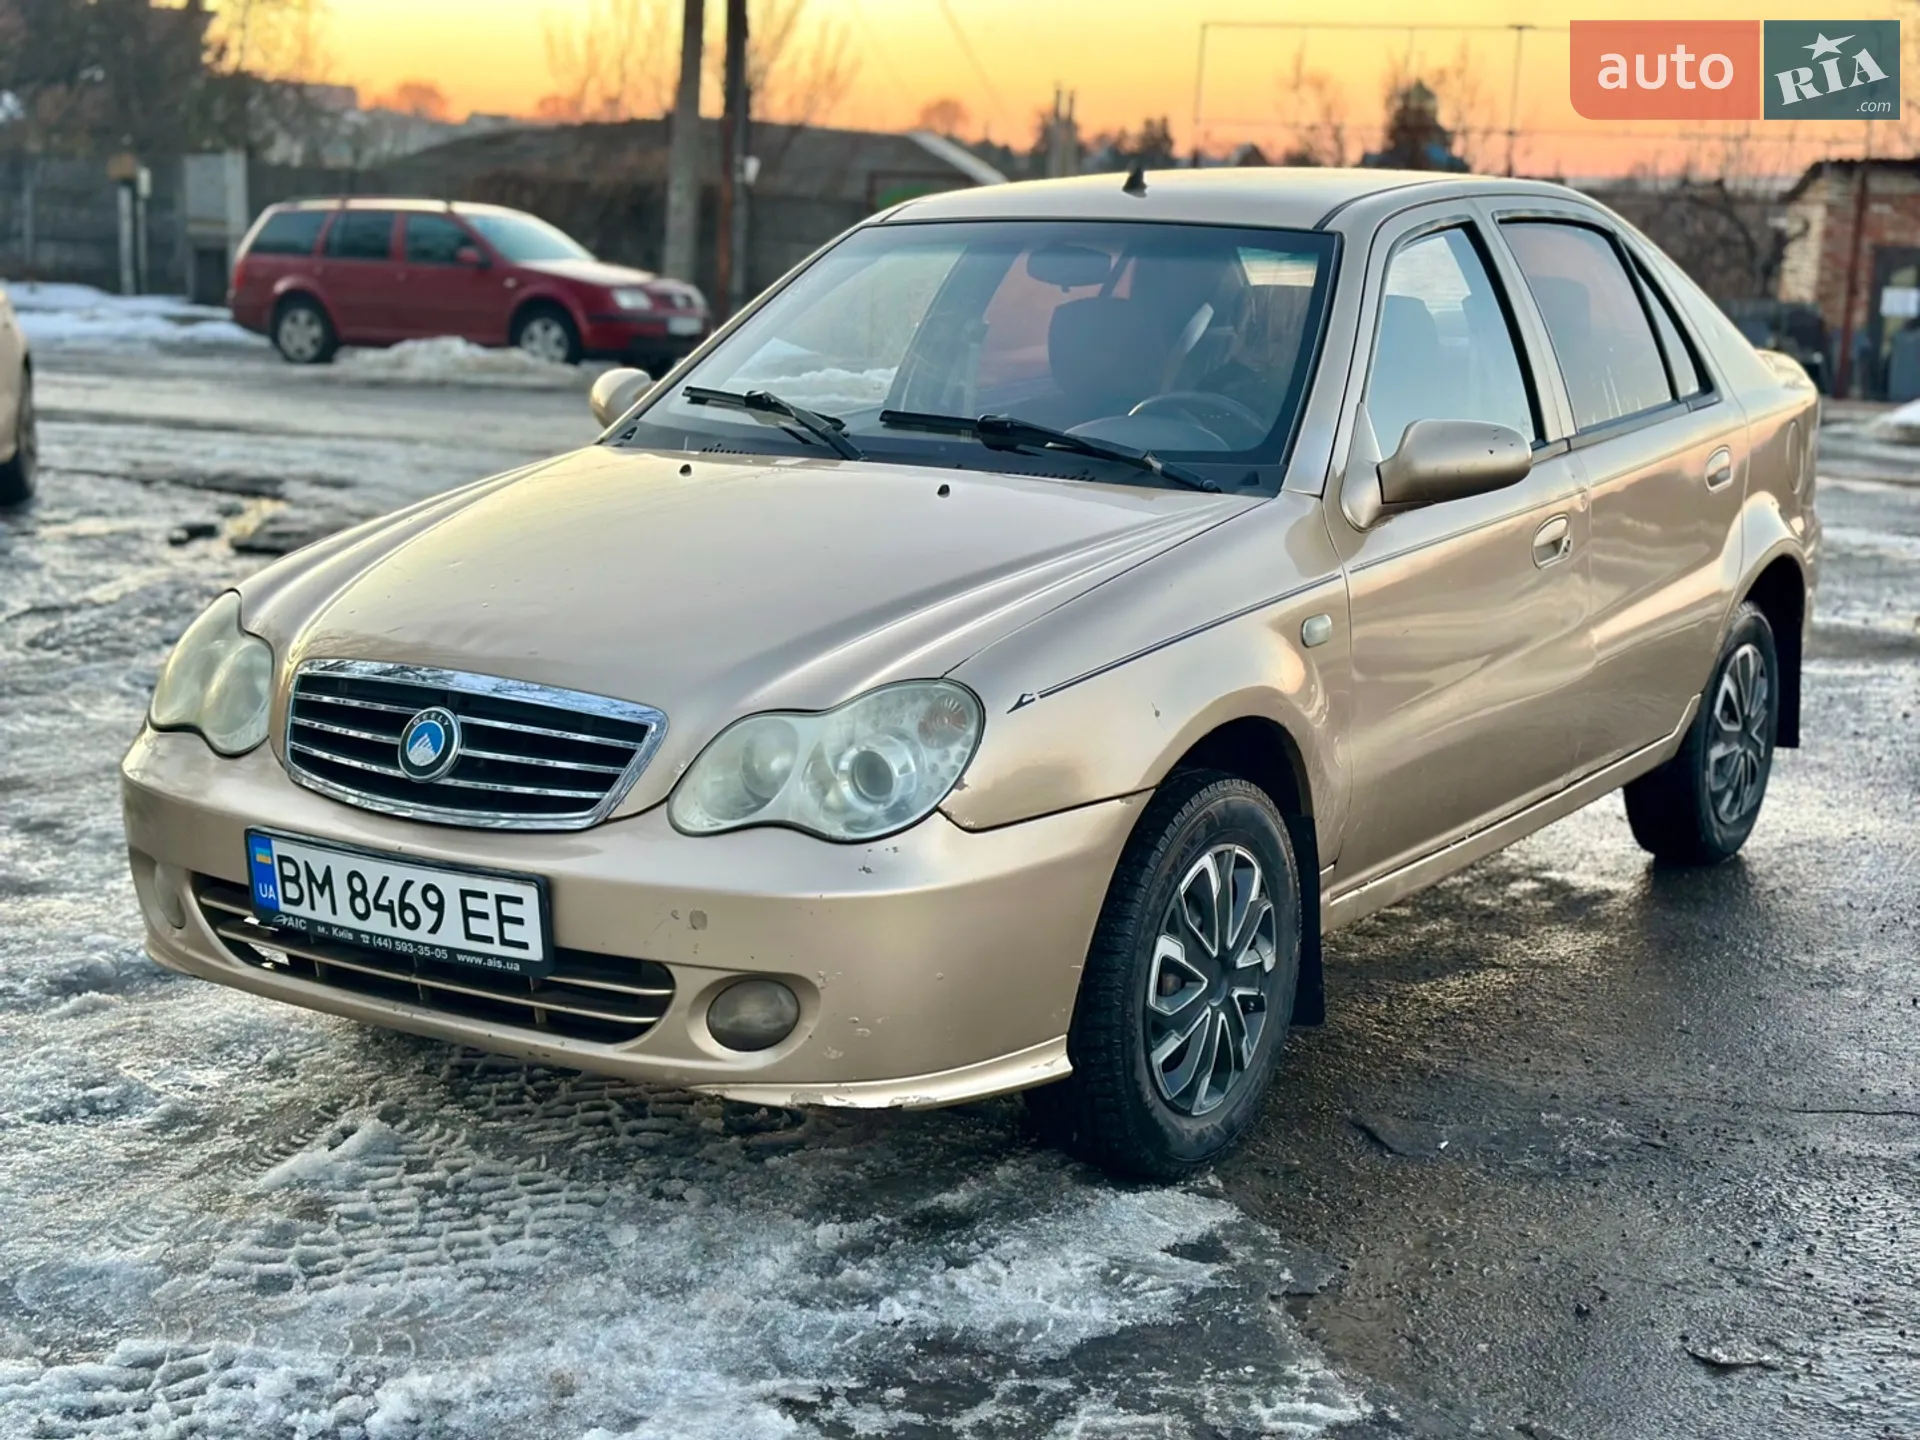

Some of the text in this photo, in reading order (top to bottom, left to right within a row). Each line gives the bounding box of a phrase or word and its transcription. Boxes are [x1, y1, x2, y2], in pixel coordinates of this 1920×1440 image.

[413, 712, 449, 726] GEELY
[259, 883, 276, 901] UA
[276, 854, 530, 951] BM 8469 EE
[372, 935, 392, 950] (44)
[395, 940, 448, 960] 593-35-05
[456, 951, 521, 972] www.ais.ua
